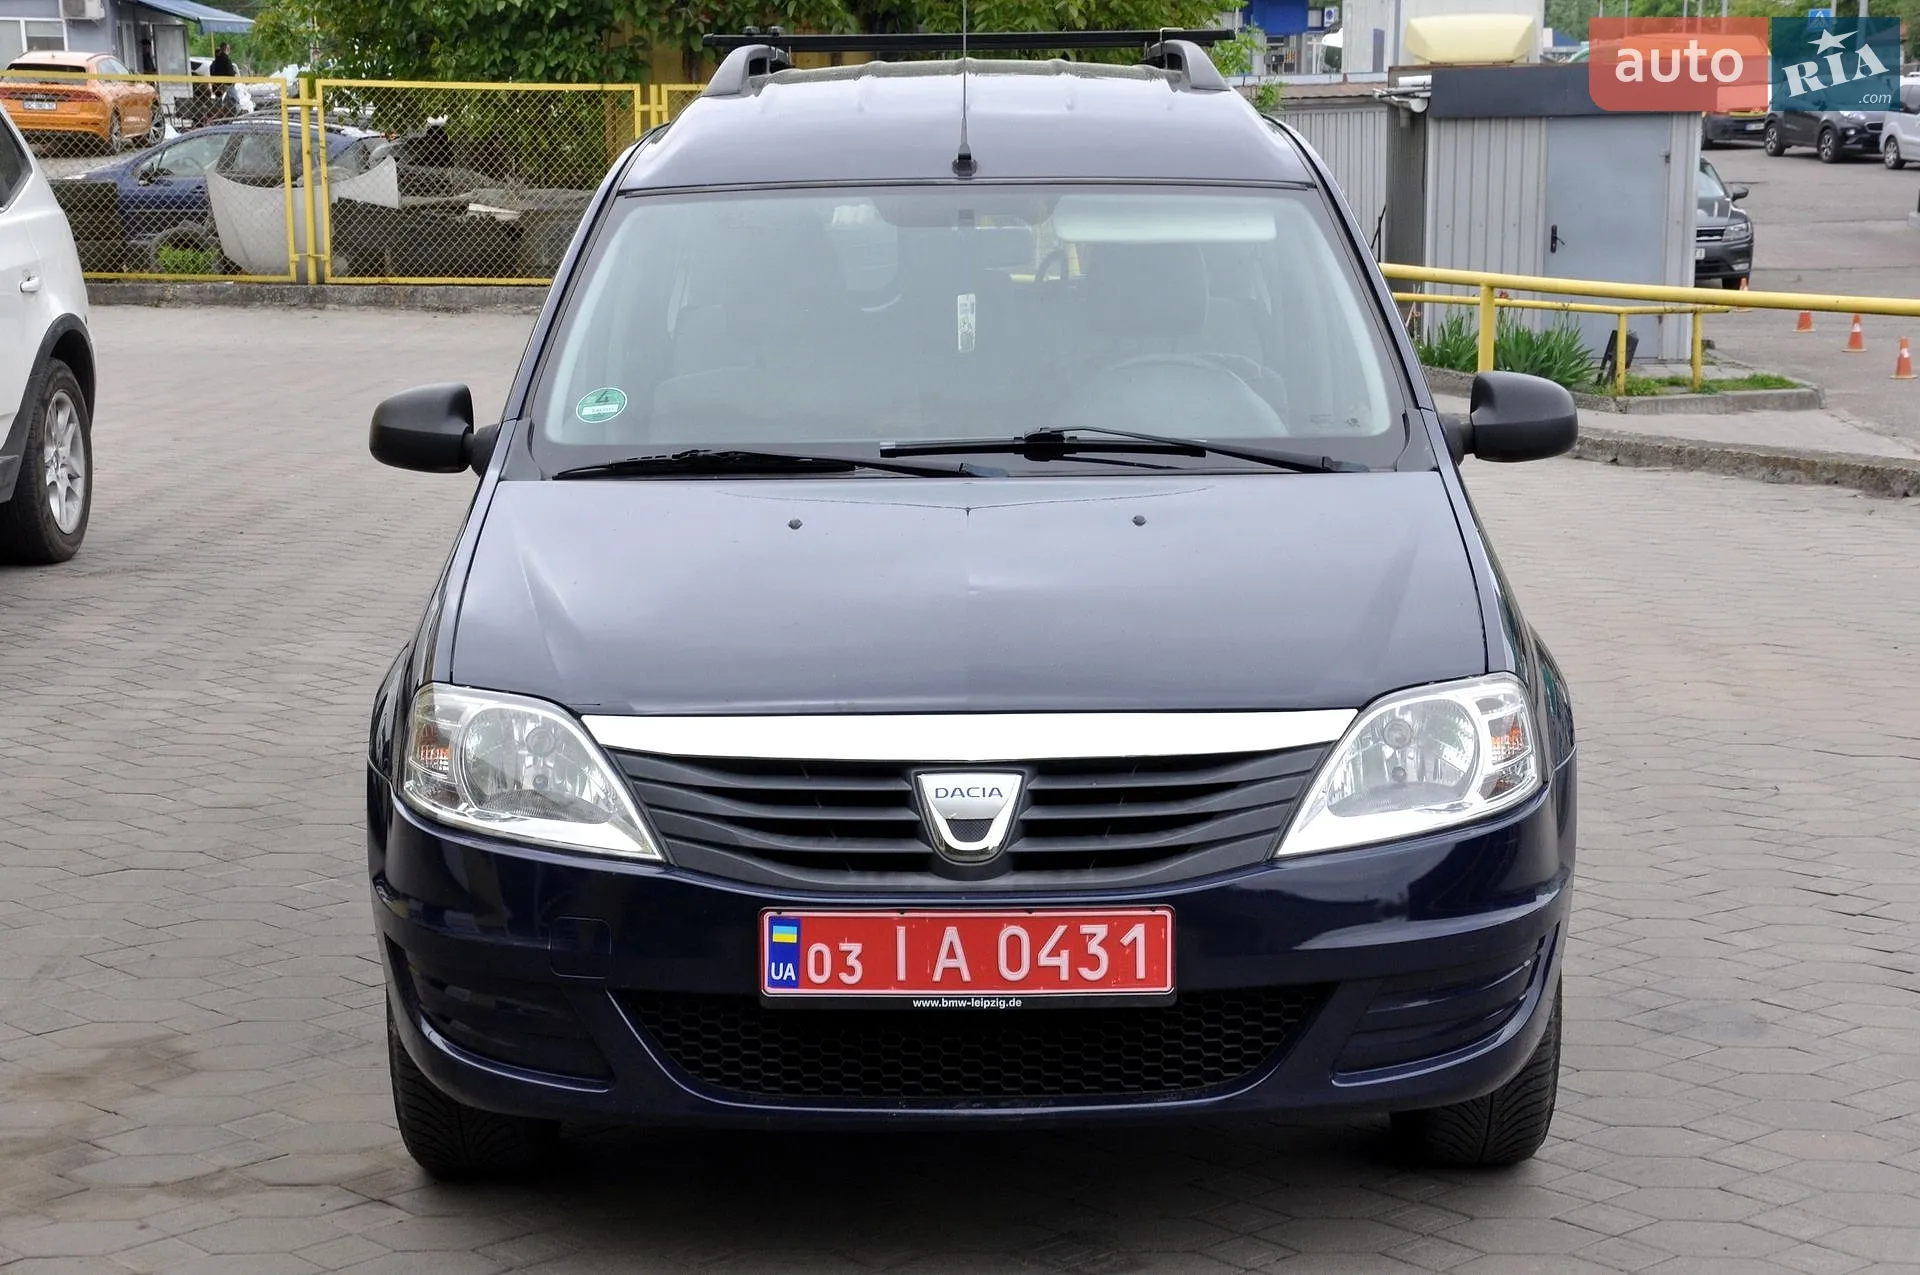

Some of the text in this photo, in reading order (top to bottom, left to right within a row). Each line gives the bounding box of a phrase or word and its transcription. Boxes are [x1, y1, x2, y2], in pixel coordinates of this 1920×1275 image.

[935, 786, 1003, 799] DACIA
[807, 942, 863, 986] 03
[997, 923, 1146, 982] 0431
[771, 962, 796, 981] UA
[912, 997, 1022, 1010] www.bmw-leipzig.de
